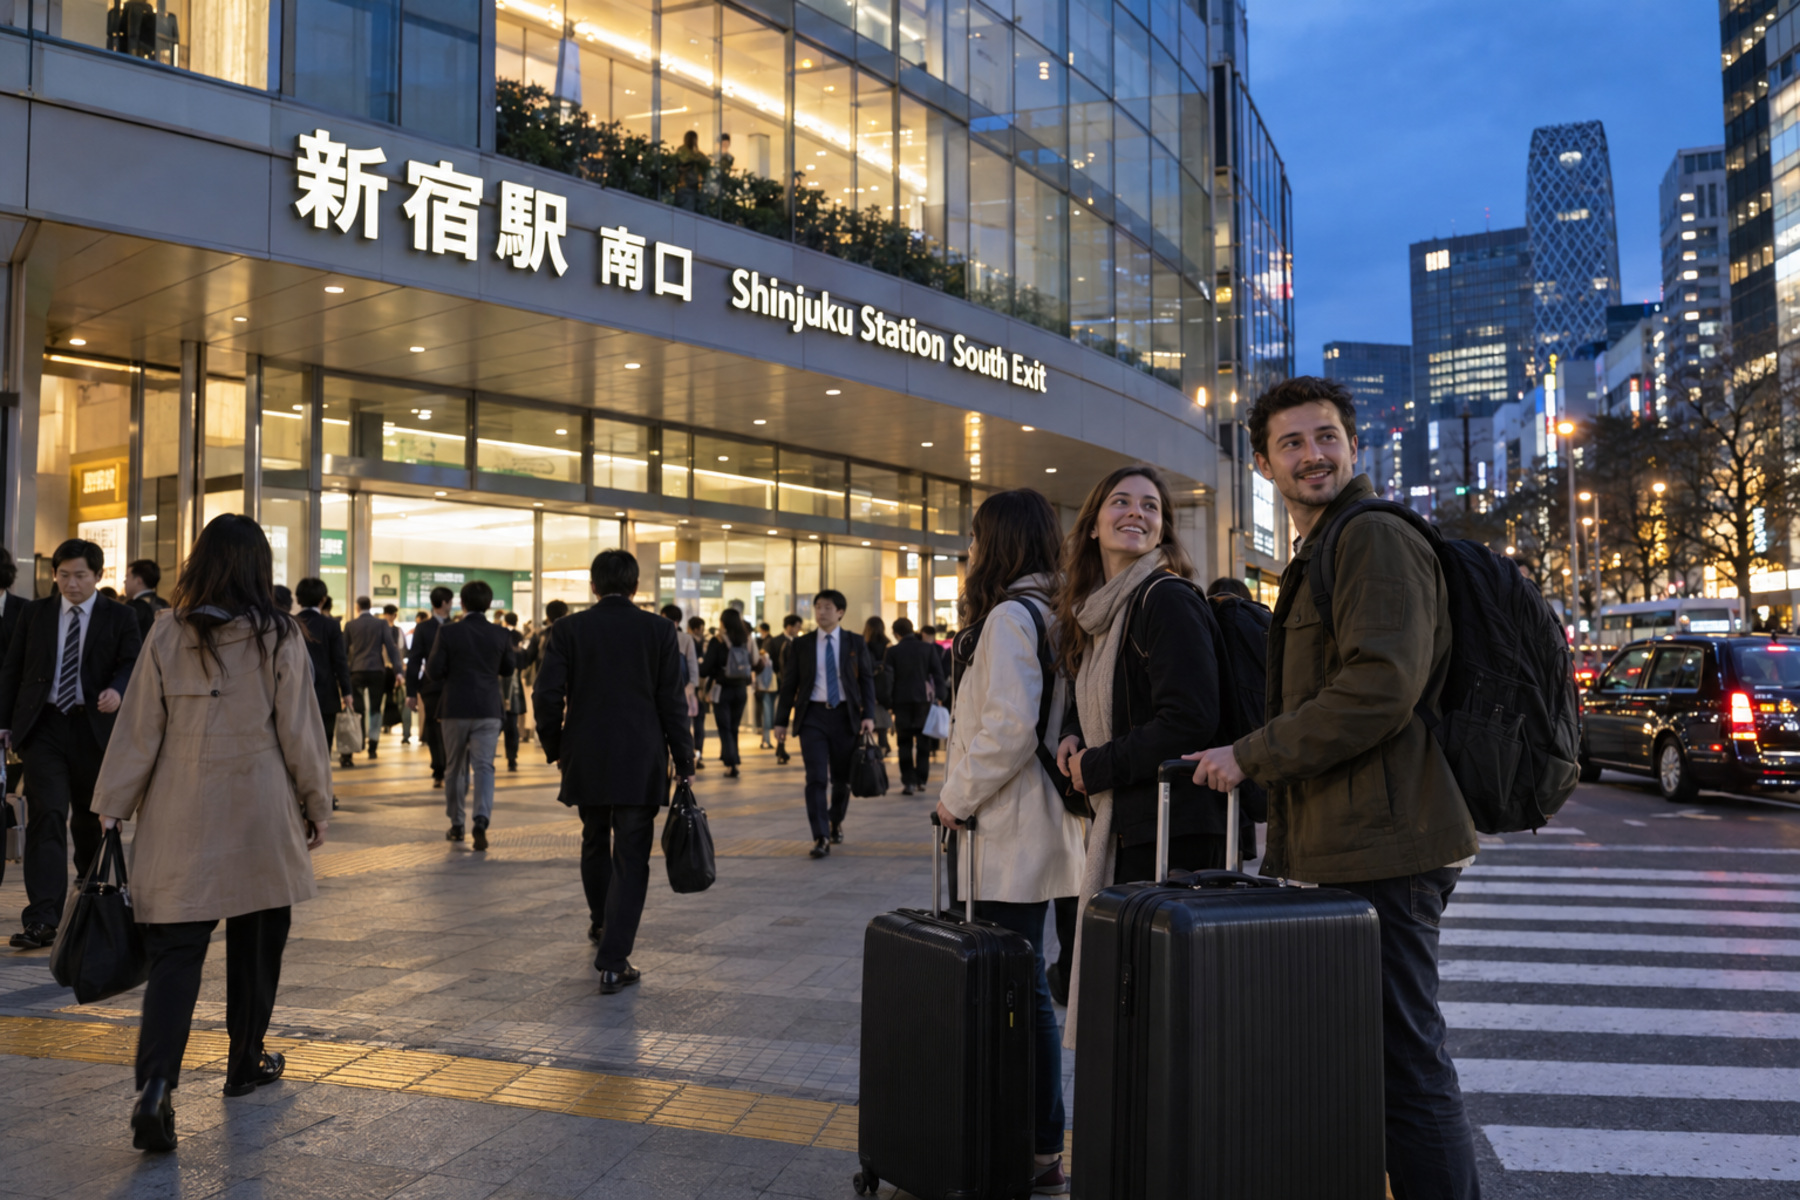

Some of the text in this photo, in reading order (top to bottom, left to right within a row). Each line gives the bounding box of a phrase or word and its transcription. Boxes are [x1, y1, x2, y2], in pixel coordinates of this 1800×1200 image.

[295, 128, 693, 302] 新宿駅 南口
[732, 268, 1048, 393] Shinjuku Station South Exit
